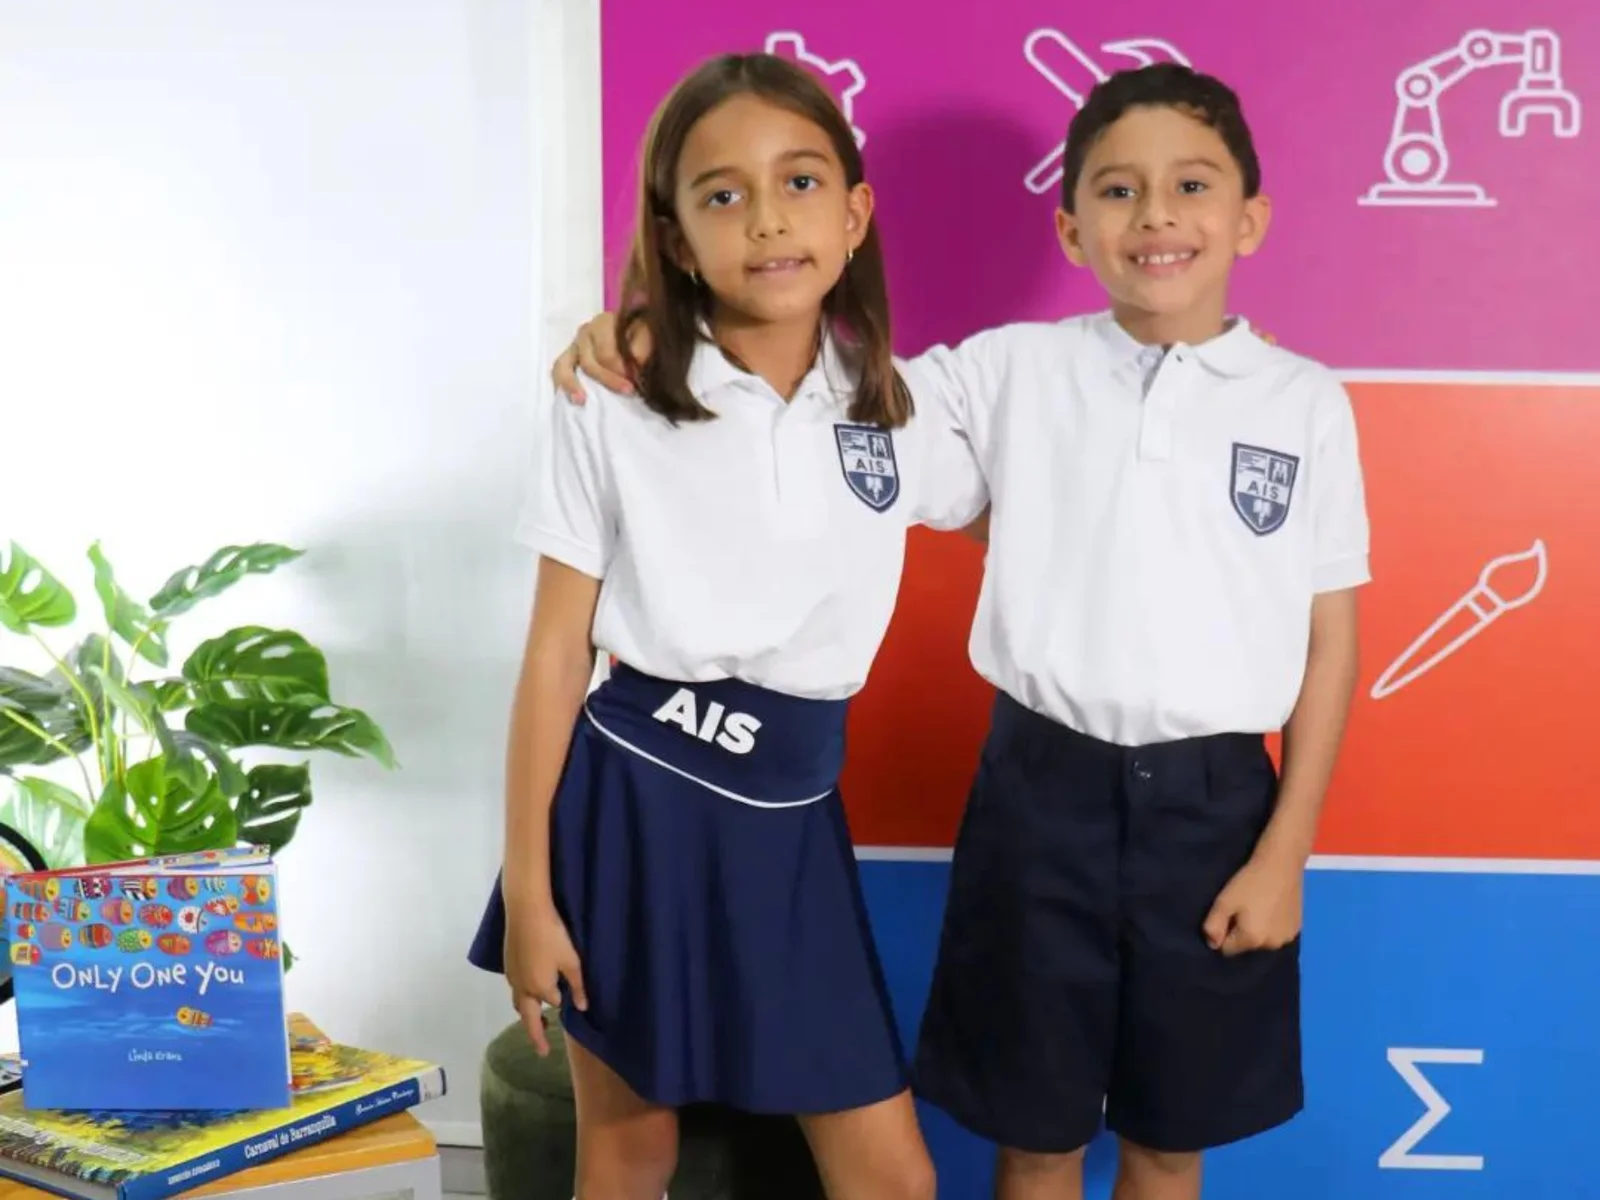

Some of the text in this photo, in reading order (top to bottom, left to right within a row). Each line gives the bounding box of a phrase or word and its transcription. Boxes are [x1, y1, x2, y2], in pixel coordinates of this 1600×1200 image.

[856, 458, 885, 473] AIS
[1248, 480, 1279, 500] AIS
[652, 688, 763, 754] AIS
[128, 1048, 153, 1062] Linda
[244, 1133, 279, 1159] Carnaval
[280, 1132, 290, 1146] de
